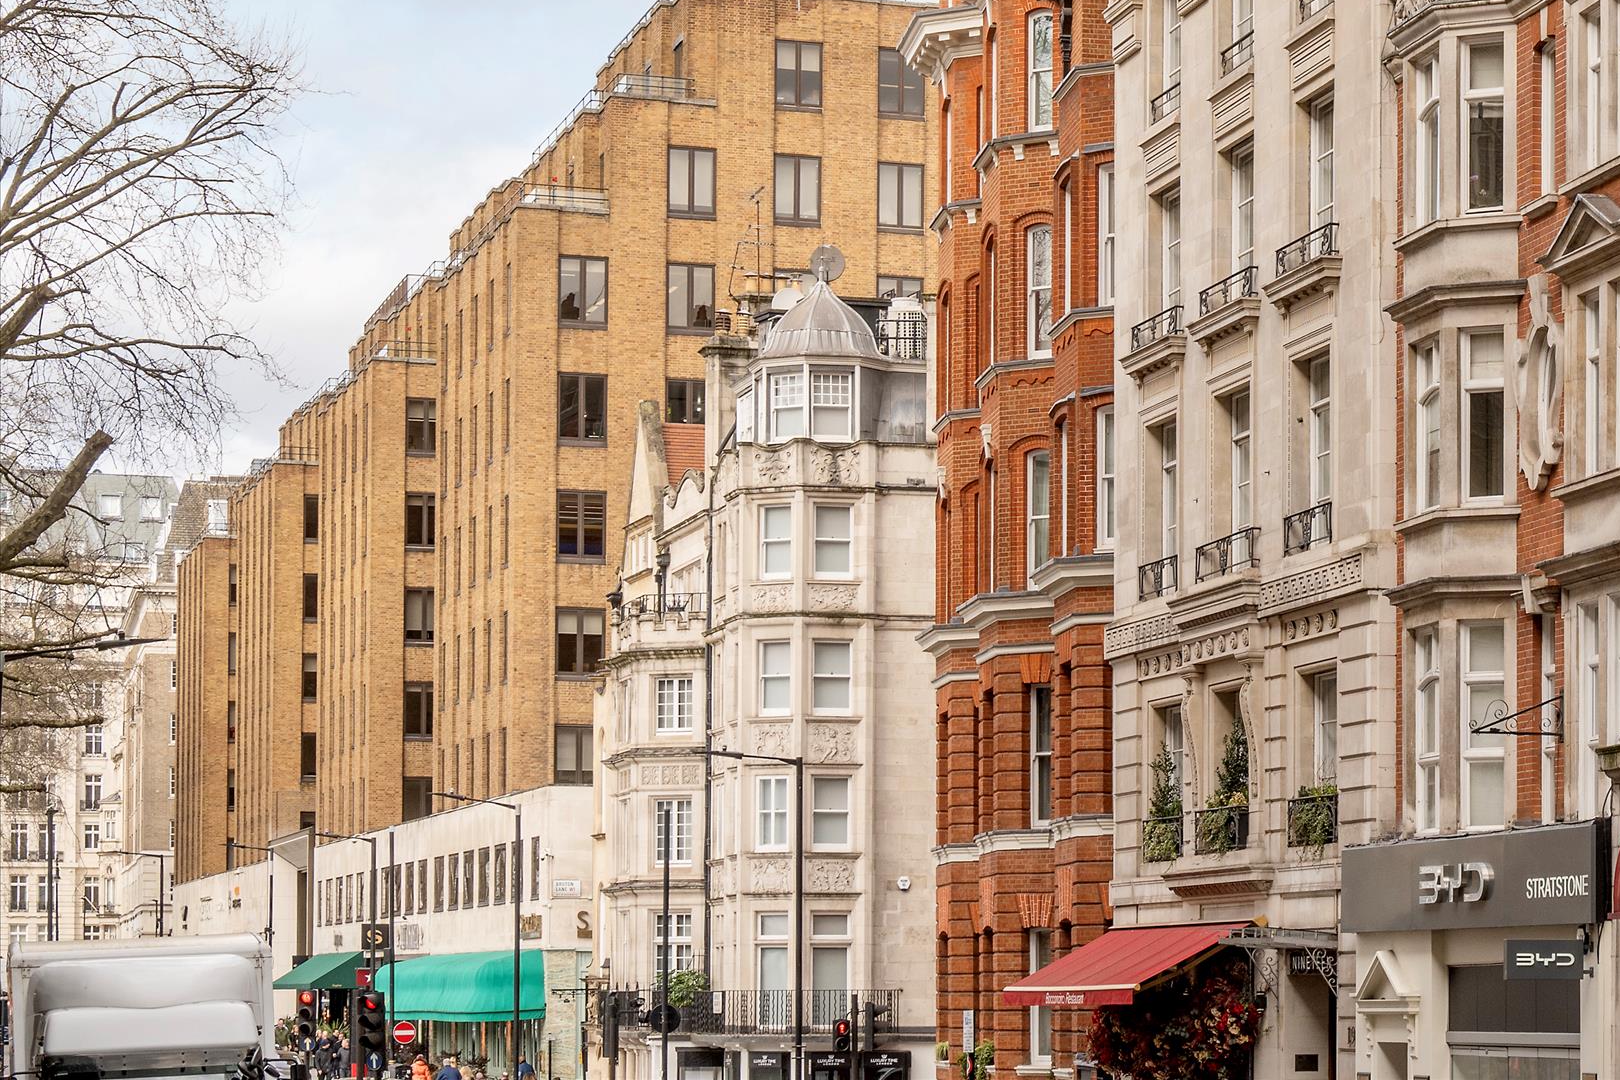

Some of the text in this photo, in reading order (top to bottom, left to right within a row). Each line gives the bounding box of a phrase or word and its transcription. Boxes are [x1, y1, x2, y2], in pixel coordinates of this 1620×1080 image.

[1419, 862, 1495, 905] BYD
[1526, 874, 1589, 900] STRATSTONE
[1516, 952, 1575, 967] BYD
